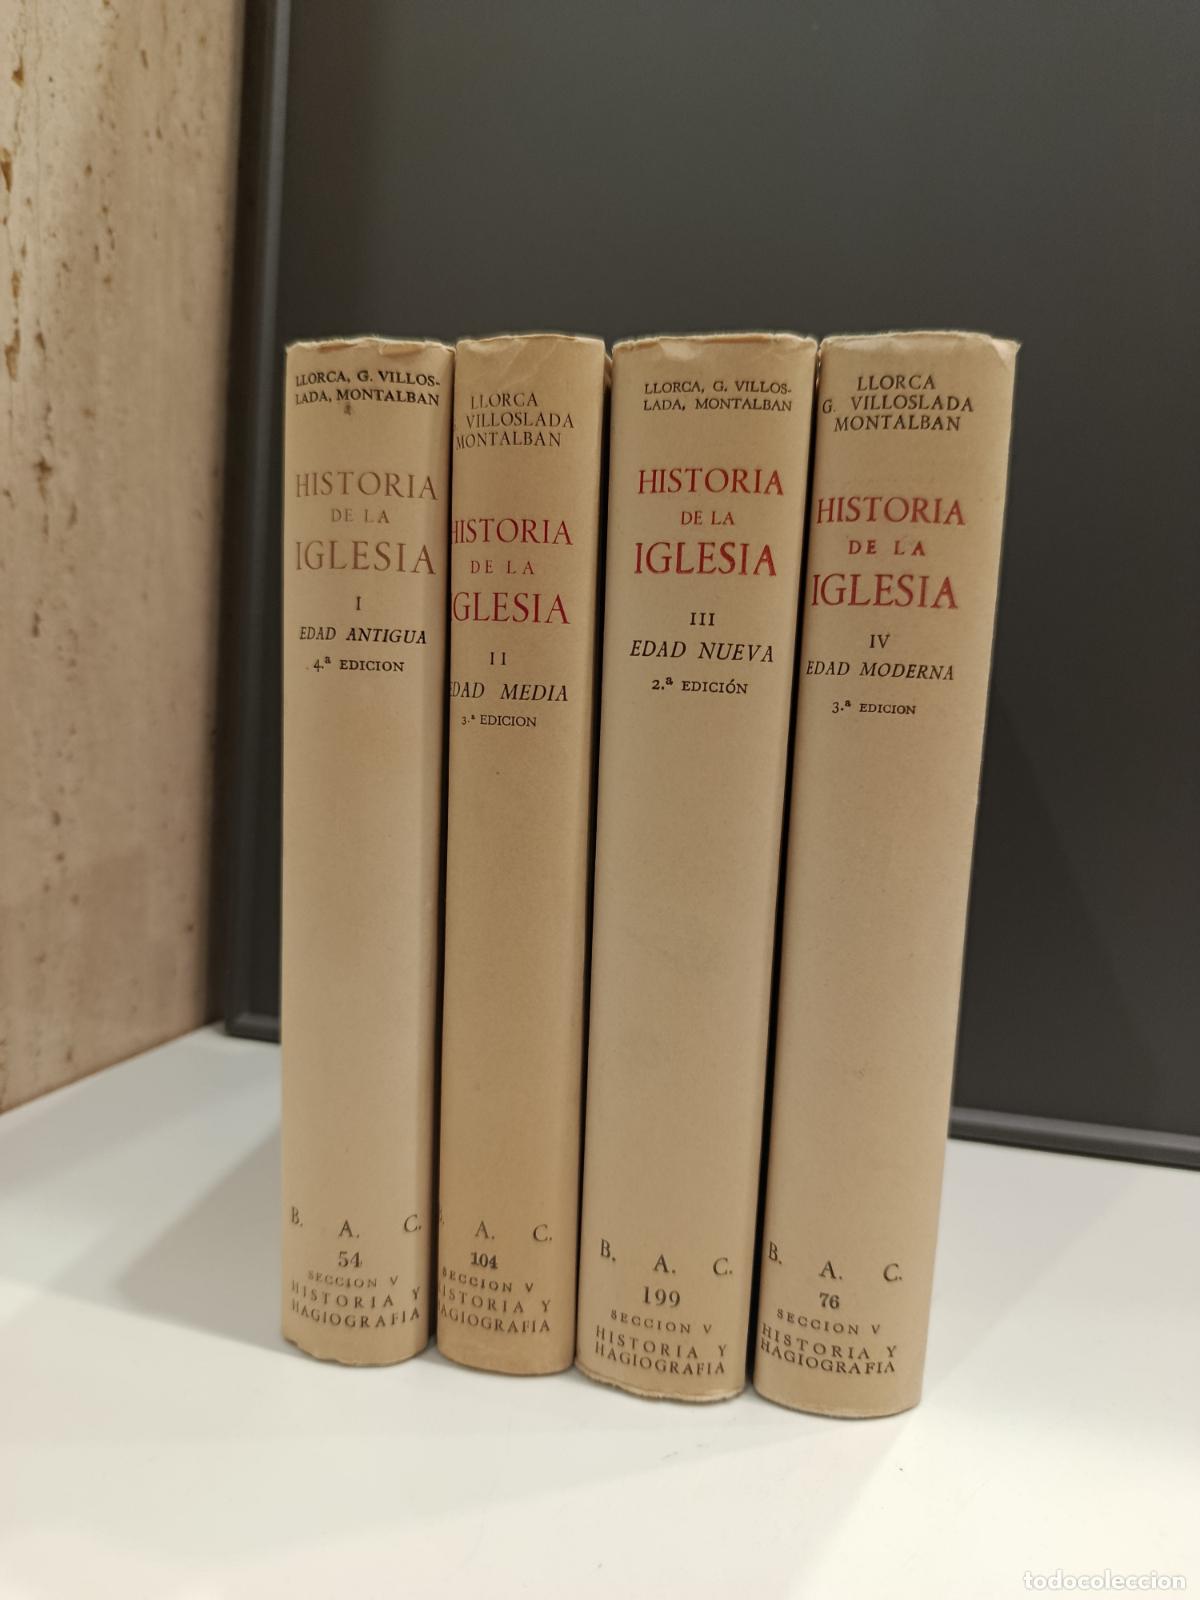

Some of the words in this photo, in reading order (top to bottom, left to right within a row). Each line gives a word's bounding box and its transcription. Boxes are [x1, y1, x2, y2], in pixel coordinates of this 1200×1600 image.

[295, 371, 351, 387] LLORCA,
[356, 370, 373, 382] G.
[378, 370, 441, 387] VILLOS-
[644, 381, 705, 395] LLORCA,
[713, 380, 728, 393] G.
[735, 380, 792, 395] VILLOS-
[857, 375, 936, 391] LLORCA
[295, 390, 332, 405] LADA,
[336, 388, 440, 406] MONTALBAN
[471, 392, 538, 410] LLORCA
[643, 399, 686, 412] LADA,
[695, 398, 792, 412] MONTALBAN
[822, 399, 836, 414] G.
[851, 395, 974, 412] VILLOSLADA
[466, 411, 575, 429] VILLOSLADA
[834, 414, 961, 433] MONTALBAN
[456, 431, 561, 450] MONTALBAN
[296, 471, 439, 501] HISTORIA
[638, 468, 784, 496] HISTORIA
[331, 508, 353, 523] DE
[364, 509, 390, 524] LA
[681, 510, 702, 525] DE
[711, 510, 735, 525] LA
[816, 496, 965, 525] HISTORIA
[296, 540, 436, 575] IGLESIA
[848, 540, 877, 554] DE
[894, 540, 925, 556] LA
[471, 560, 494, 574] DE
[507, 560, 535, 575] LA
[634, 542, 777, 576] IGLESIA
[811, 573, 958, 609] IGLESIA
[356, 596, 362, 611] I
[452, 591, 570, 624] GLESIA
[690, 612, 715, 626] III
[299, 626, 336, 641] EDAD
[346, 627, 427, 644] ANTIGUA
[869, 634, 891, 648] IV
[630, 640, 687, 658] EDAD
[698, 642, 774, 663] NUEVA
[339, 659, 405, 672] EDICION
[806, 660, 850, 676] EDAD
[859, 661, 954, 681] MODERNA
[500, 683, 568, 702] MEDIA
[682, 679, 748, 694] EDICIÓN
[859, 703, 917, 715] EDICION
[480, 715, 537, 728] EDICION
[291, 1206, 303, 1227] B.
[338, 1219, 360, 1238] A.
[403, 1214, 422, 1233] C.
[474, 1220, 495, 1240] A.
[532, 1223, 552, 1242] C.
[338, 1251, 362, 1268] 54
[470, 1251, 498, 1270] 104
[600, 1239, 616, 1262] B.
[653, 1253, 676, 1274] A.
[712, 1257, 733, 1276] C.
[768, 1241, 782, 1265] B.
[818, 1260, 843, 1280] A.
[883, 1263, 902, 1282] C.
[308, 1270, 377, 1288] SECCION
[389, 1275, 399, 1286] V
[442, 1266, 512, 1293] SECCION
[524, 1282, 534, 1293] V
[291, 1279, 394, 1309] HISTORIA
[412, 1286, 420, 1300] Y
[442, 1283, 524, 1314] ISTORIA
[541, 1299, 551, 1313] Y
[643, 1286, 681, 1307] 199
[819, 1292, 840, 1309] 76
[291, 1298, 420, 1328] HAGIOGRAFIA
[440, 1303, 550, 1334] AGIOGRAFIA
[611, 1309, 690, 1334] SECCION
[703, 1324, 712, 1334] V
[777, 1308, 858, 1335] SECCION
[871, 1324, 881, 1334] V
[596, 1325, 698, 1359] HISTORIA
[718, 1344, 727, 1357] Y
[762, 1323, 870, 1360] HISTORIA
[886, 1345, 897, 1358] Y
[595, 1341, 725, 1376] HAGIOGRAFIA
[760, 1337, 895, 1375] HAGIOGRAFIA
